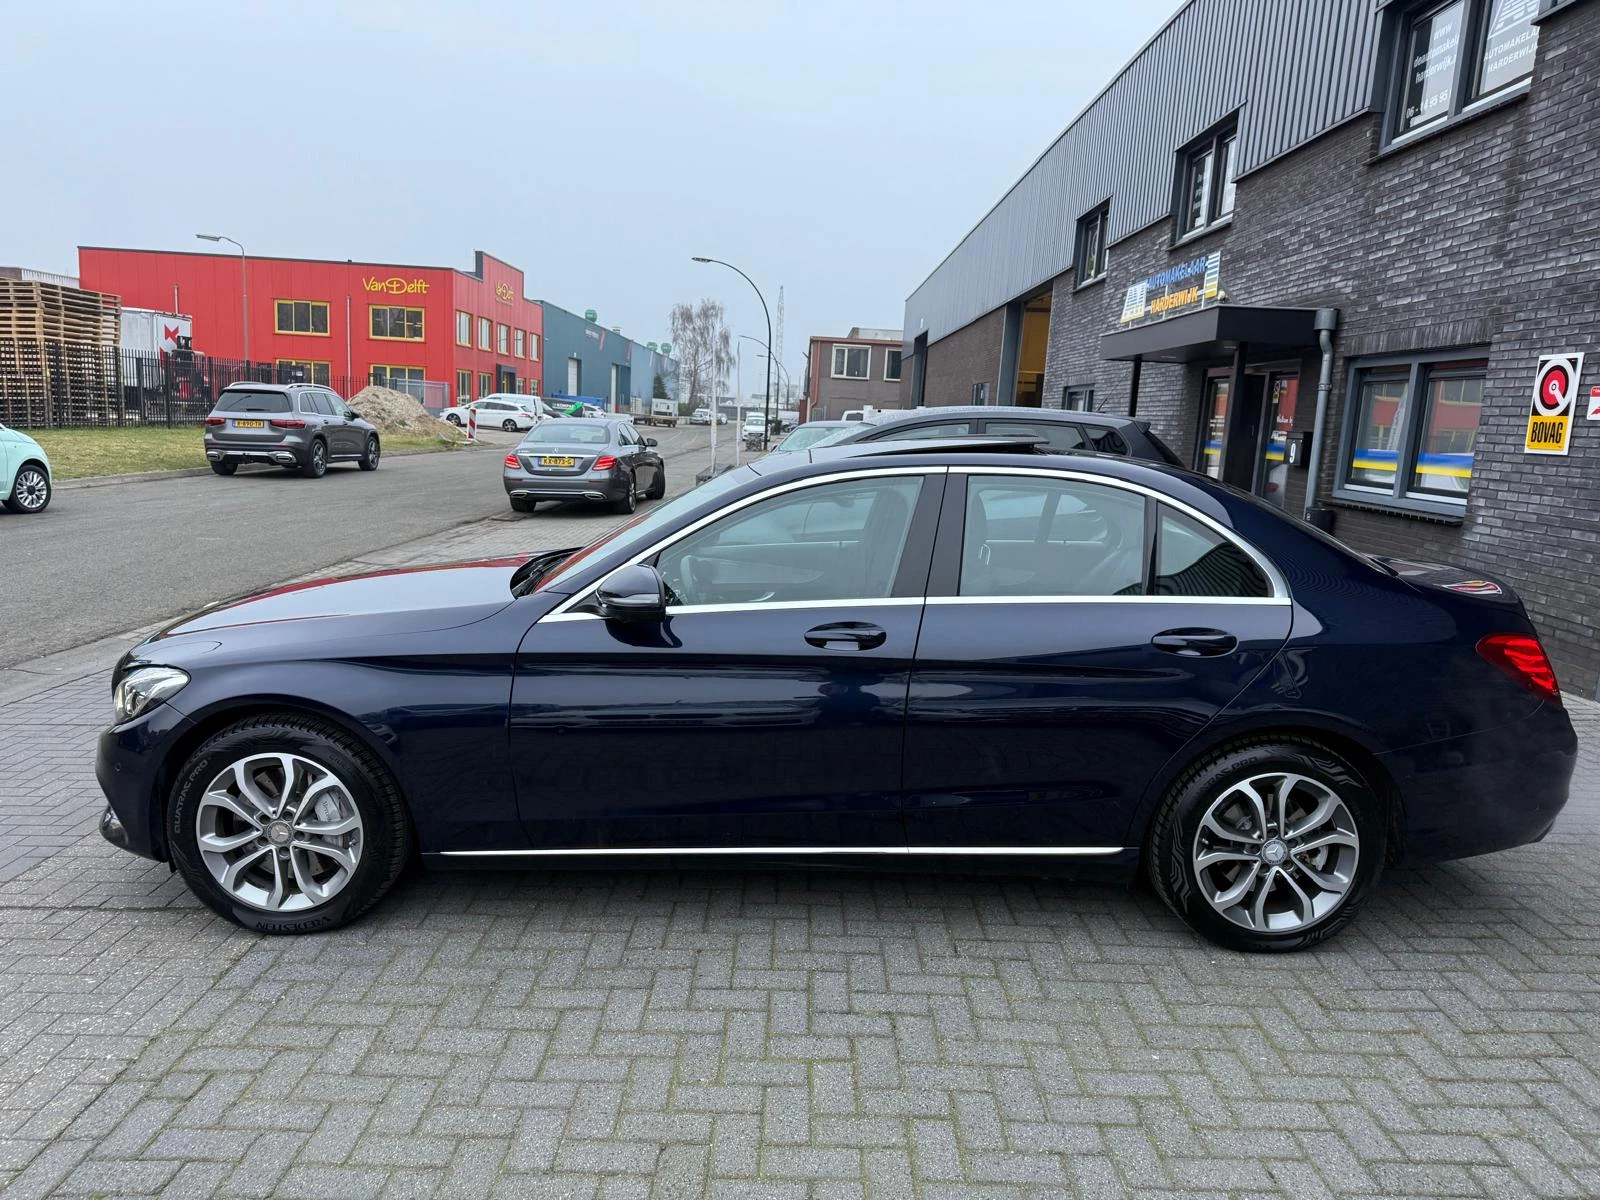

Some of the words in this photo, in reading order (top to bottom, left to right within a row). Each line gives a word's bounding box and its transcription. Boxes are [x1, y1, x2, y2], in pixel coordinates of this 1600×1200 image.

[1413, 35, 1458, 68] deautomakel
[1484, 26, 1540, 61] AUTOMAKELA
[1415, 54, 1456, 84] harderwijk.
[1146, 256, 1207, 289] AUTOMAKELAAR
[1151, 286, 1199, 314] HARDERWIJK
[1530, 421, 1563, 444] BOVAG
[1289, 442, 1297, 464] 9
[188, 759, 208, 782] PRO
